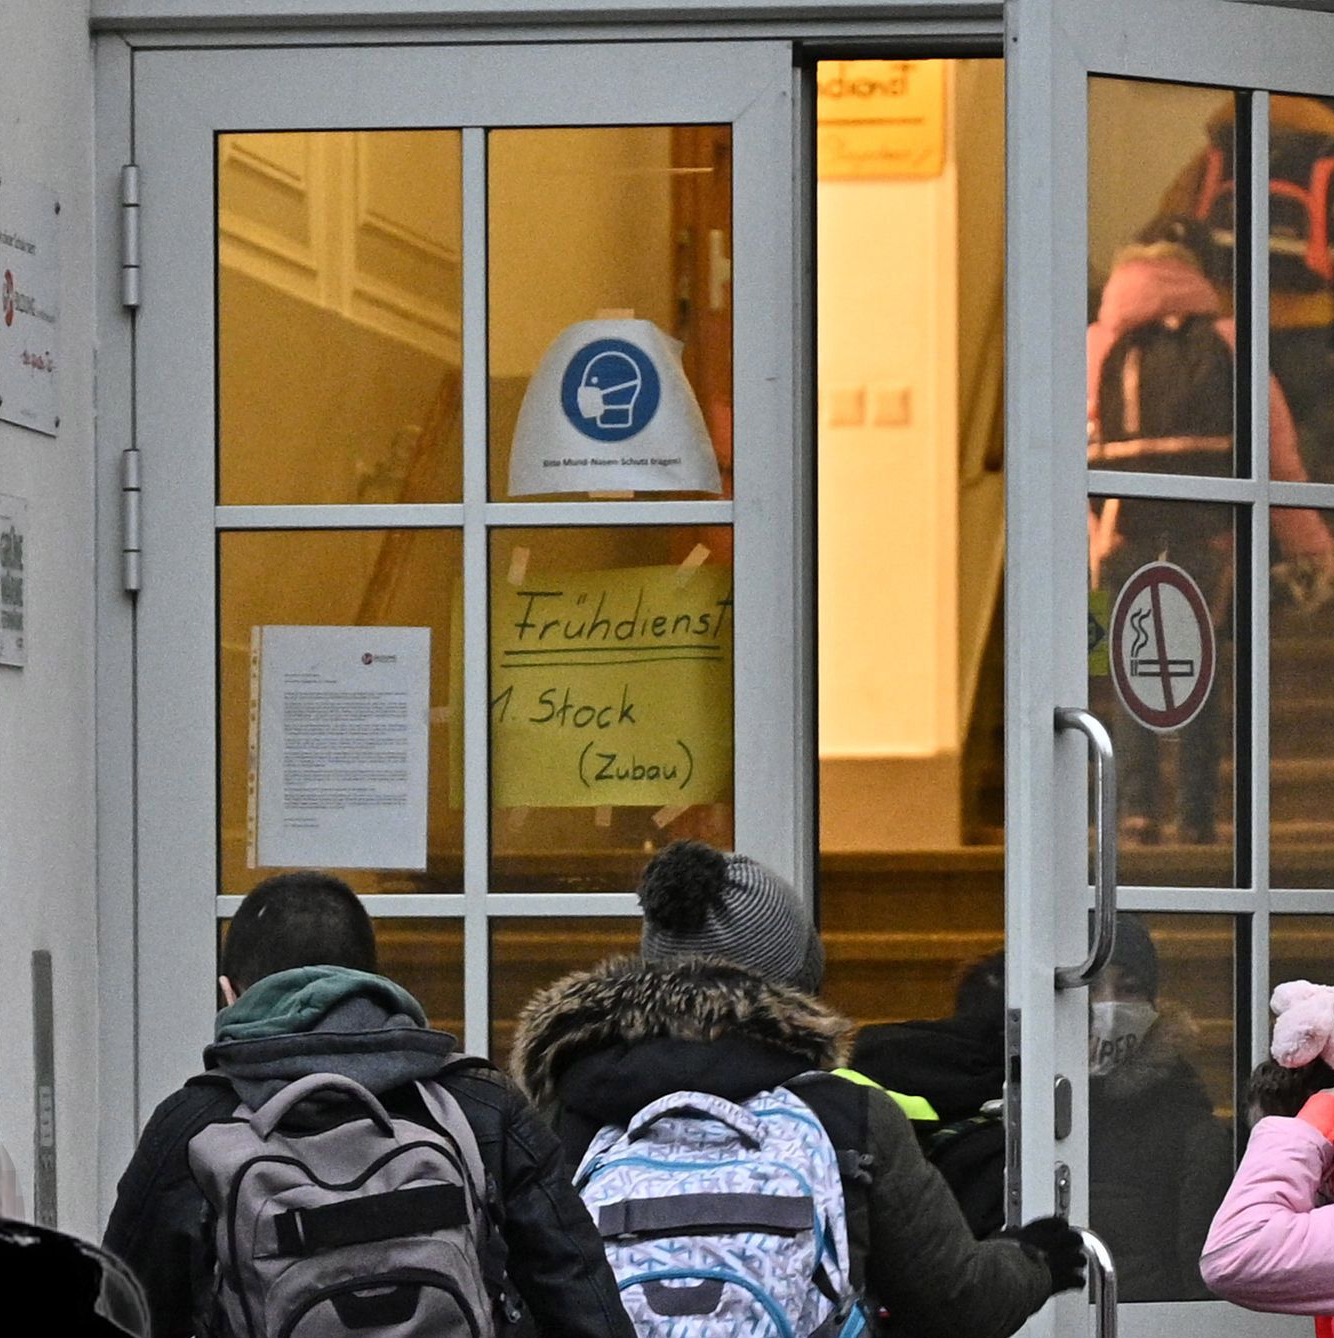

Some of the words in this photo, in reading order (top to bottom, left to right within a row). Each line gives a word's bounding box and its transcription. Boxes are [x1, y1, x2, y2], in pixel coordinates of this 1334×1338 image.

[514, 588, 734, 641] Frühdienst
[529, 683, 636, 730] Stock
[578, 740, 694, 790] (Zubau)
